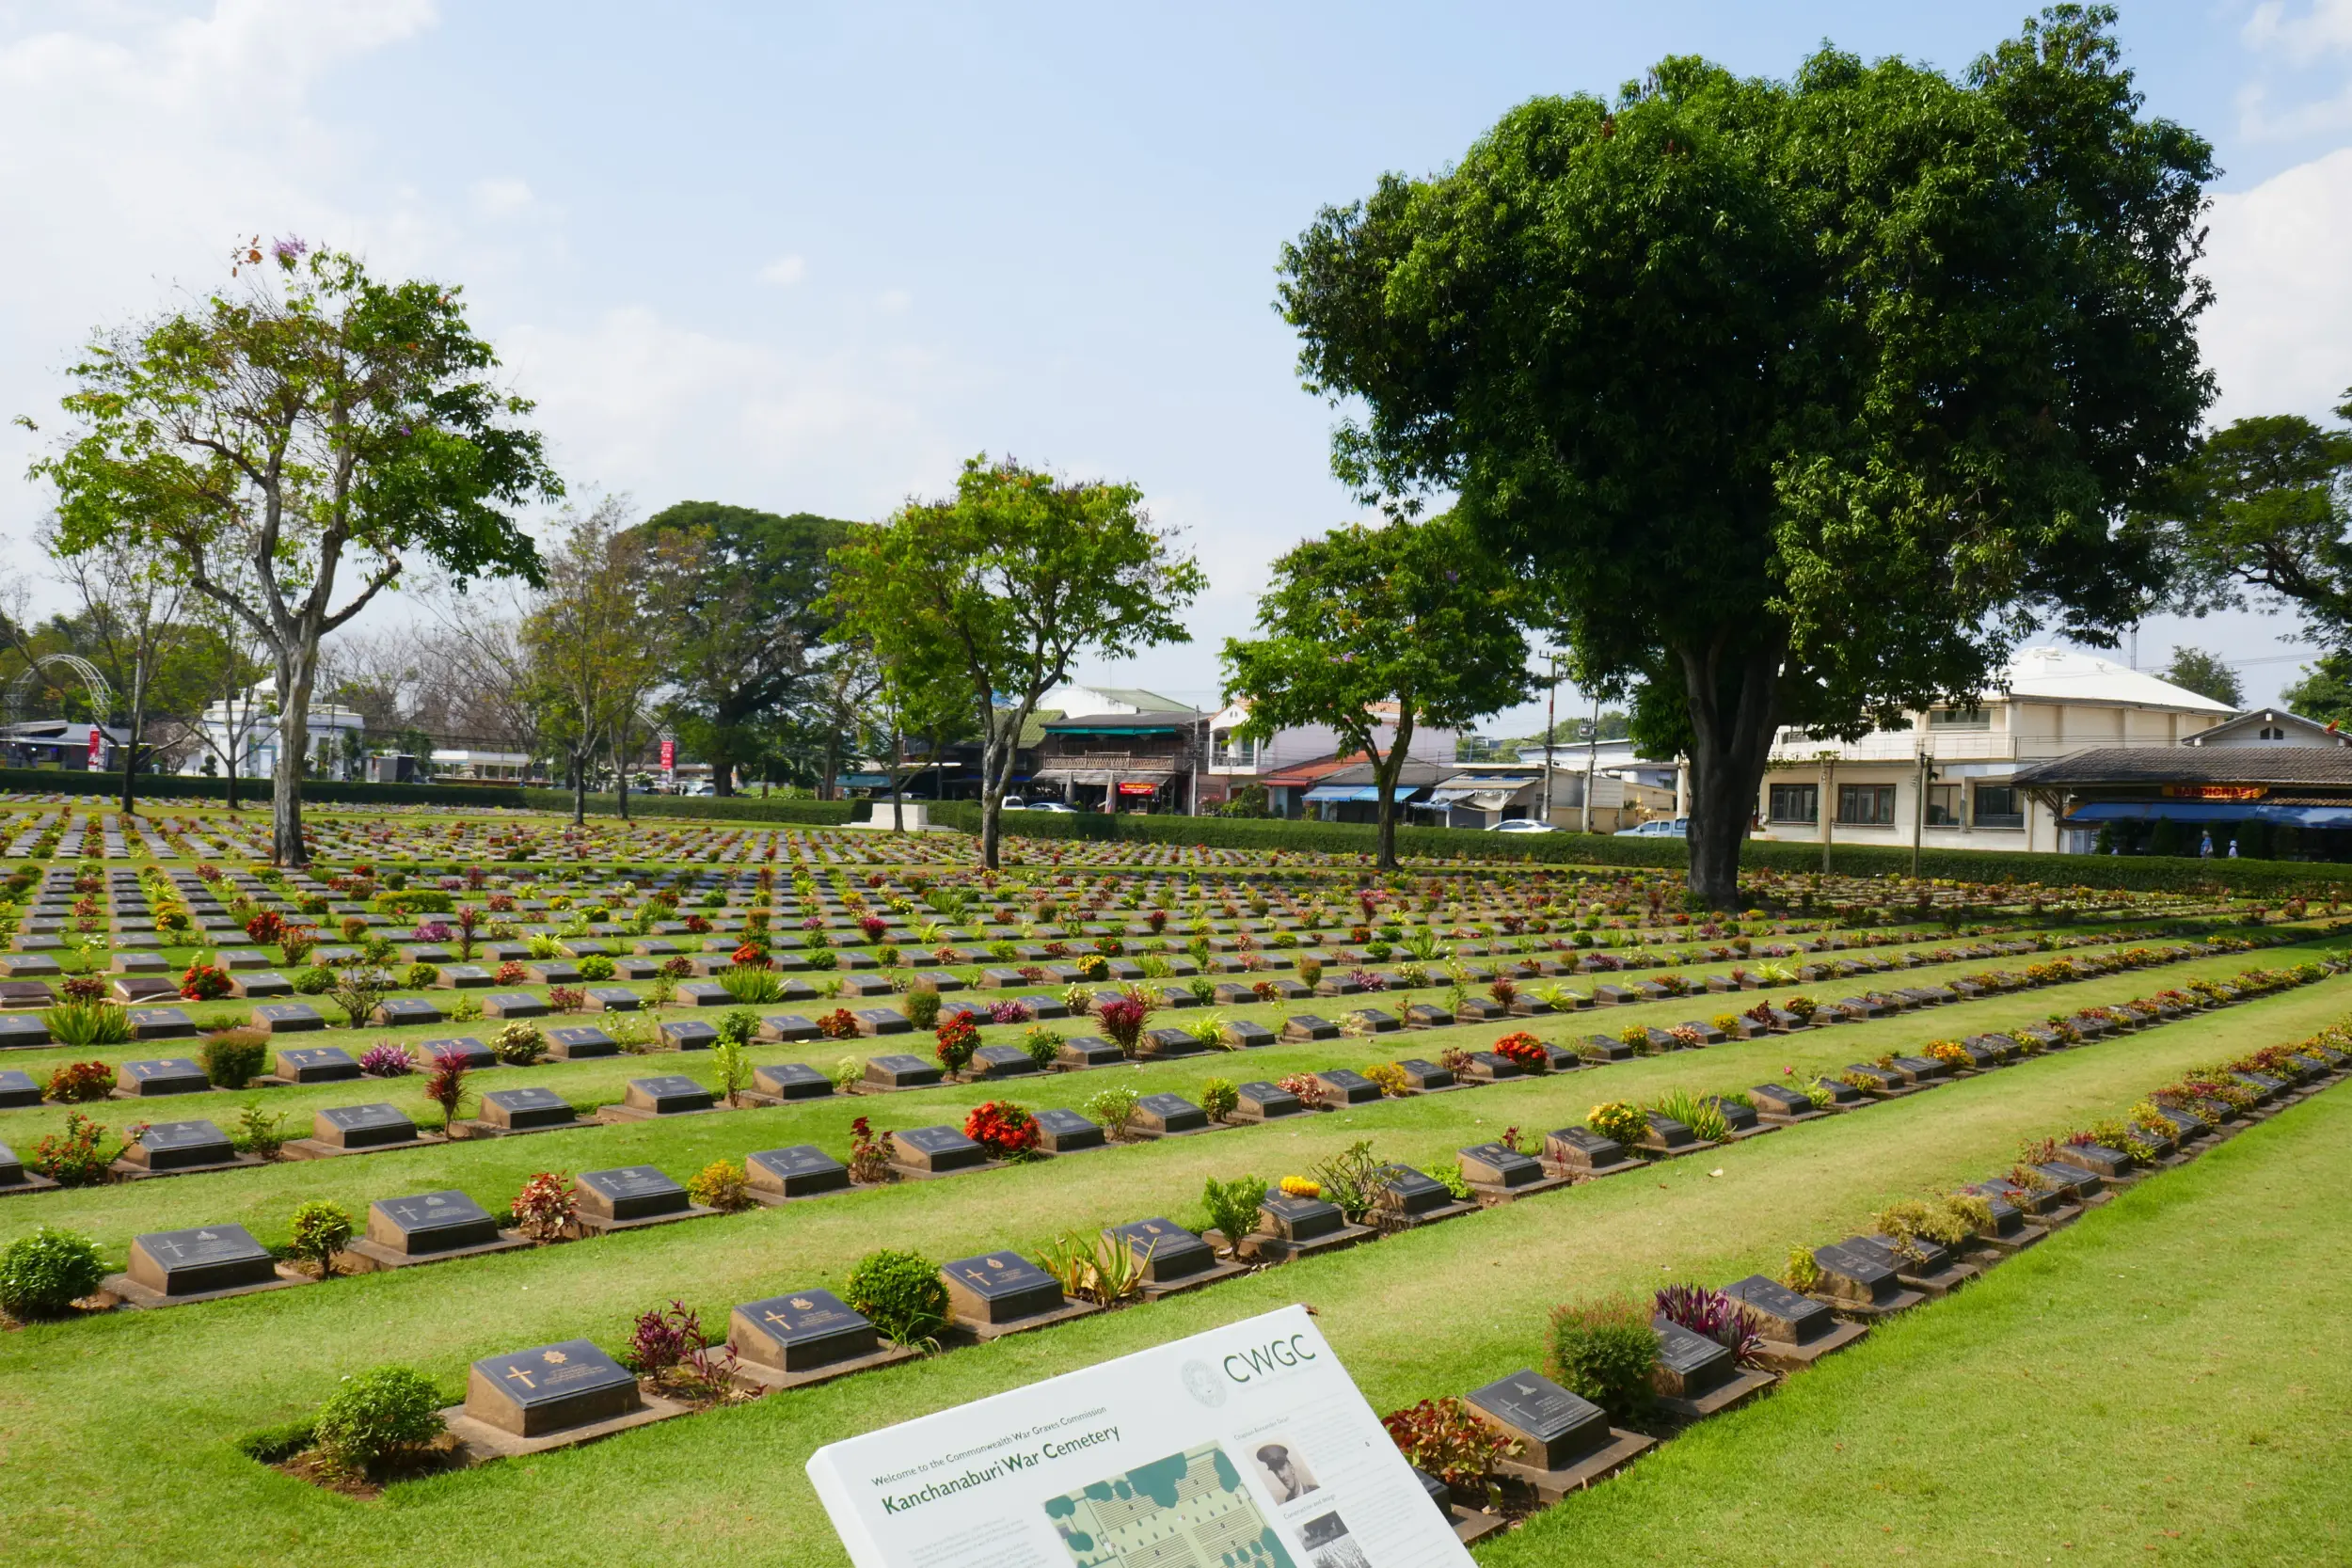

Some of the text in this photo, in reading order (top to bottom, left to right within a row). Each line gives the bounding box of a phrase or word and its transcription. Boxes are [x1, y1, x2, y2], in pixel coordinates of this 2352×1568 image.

[1223, 1334, 1316, 1383] CWGC
[871, 1405, 1107, 1487] Welcome to the Commonwealth War Graves Commission
[882, 1425, 1120, 1514] Kanchanaburi War Cemetery
